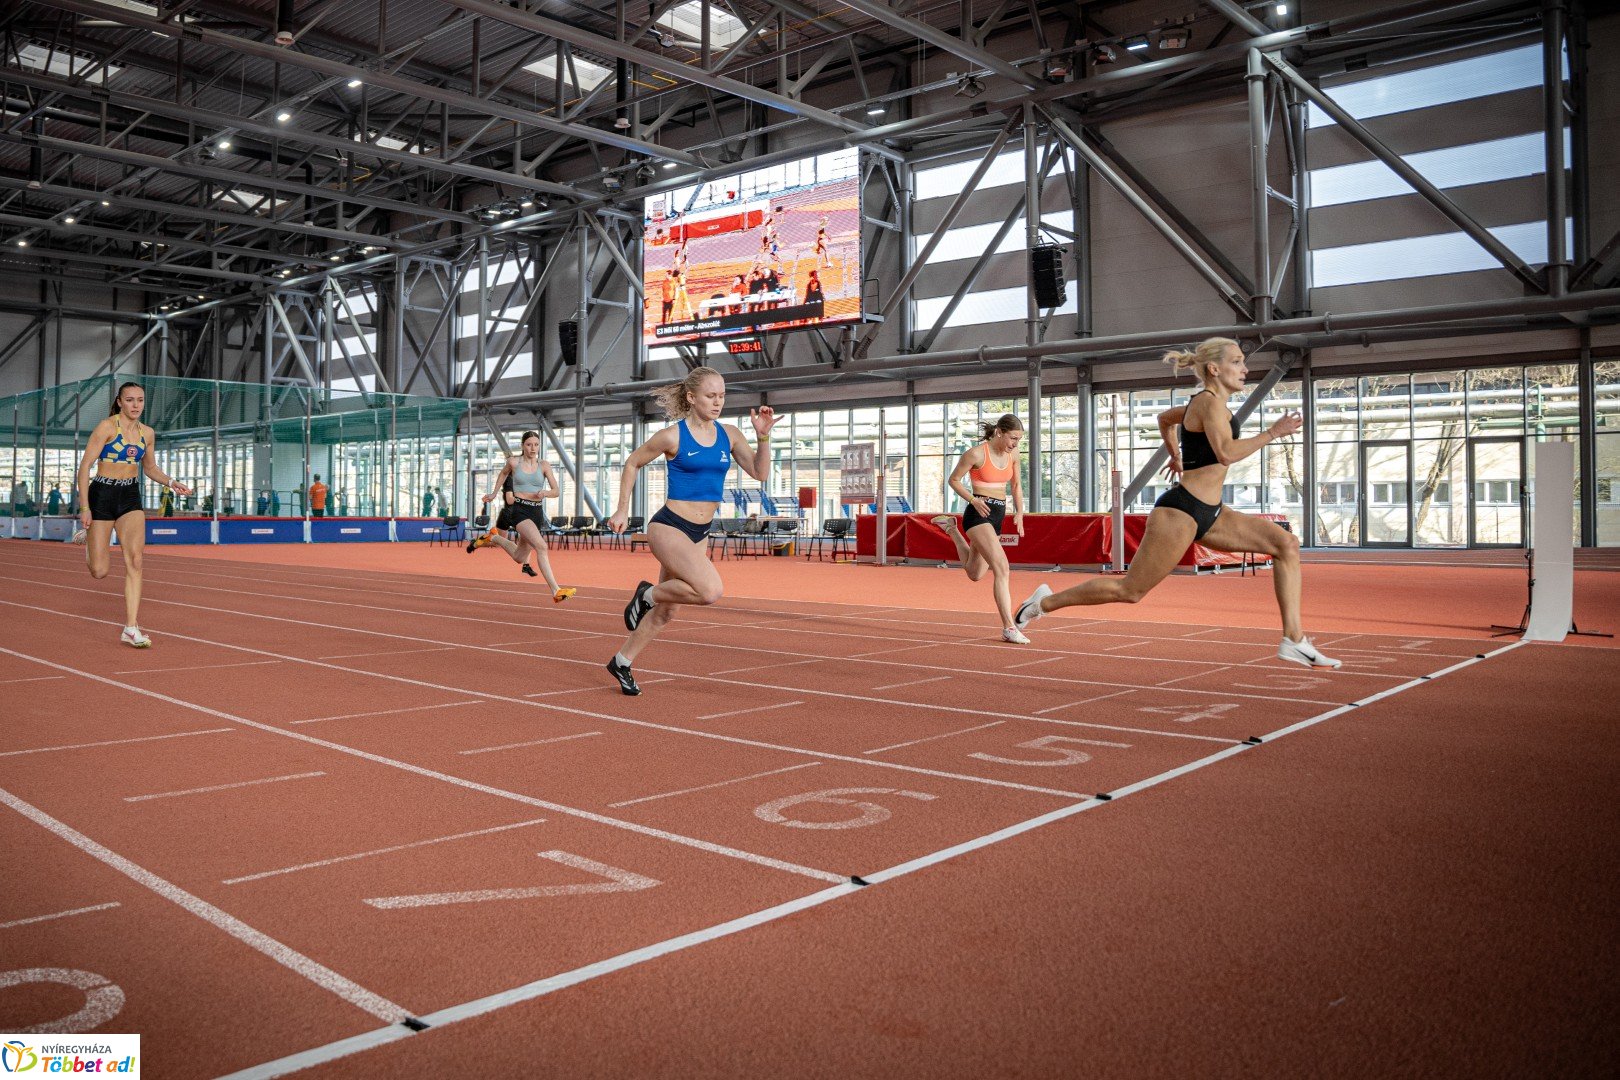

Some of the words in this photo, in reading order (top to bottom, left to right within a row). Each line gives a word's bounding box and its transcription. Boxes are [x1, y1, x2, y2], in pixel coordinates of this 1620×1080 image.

[729, 342, 761, 353] 12:39:41
[114, 477, 134, 487] PRO
[1232, 674, 1333, 691] 3
[1137, 703, 1240, 723] 4
[967, 735, 1134, 768] 5
[752, 787, 940, 830] 6
[361, 850, 664, 910] 7
